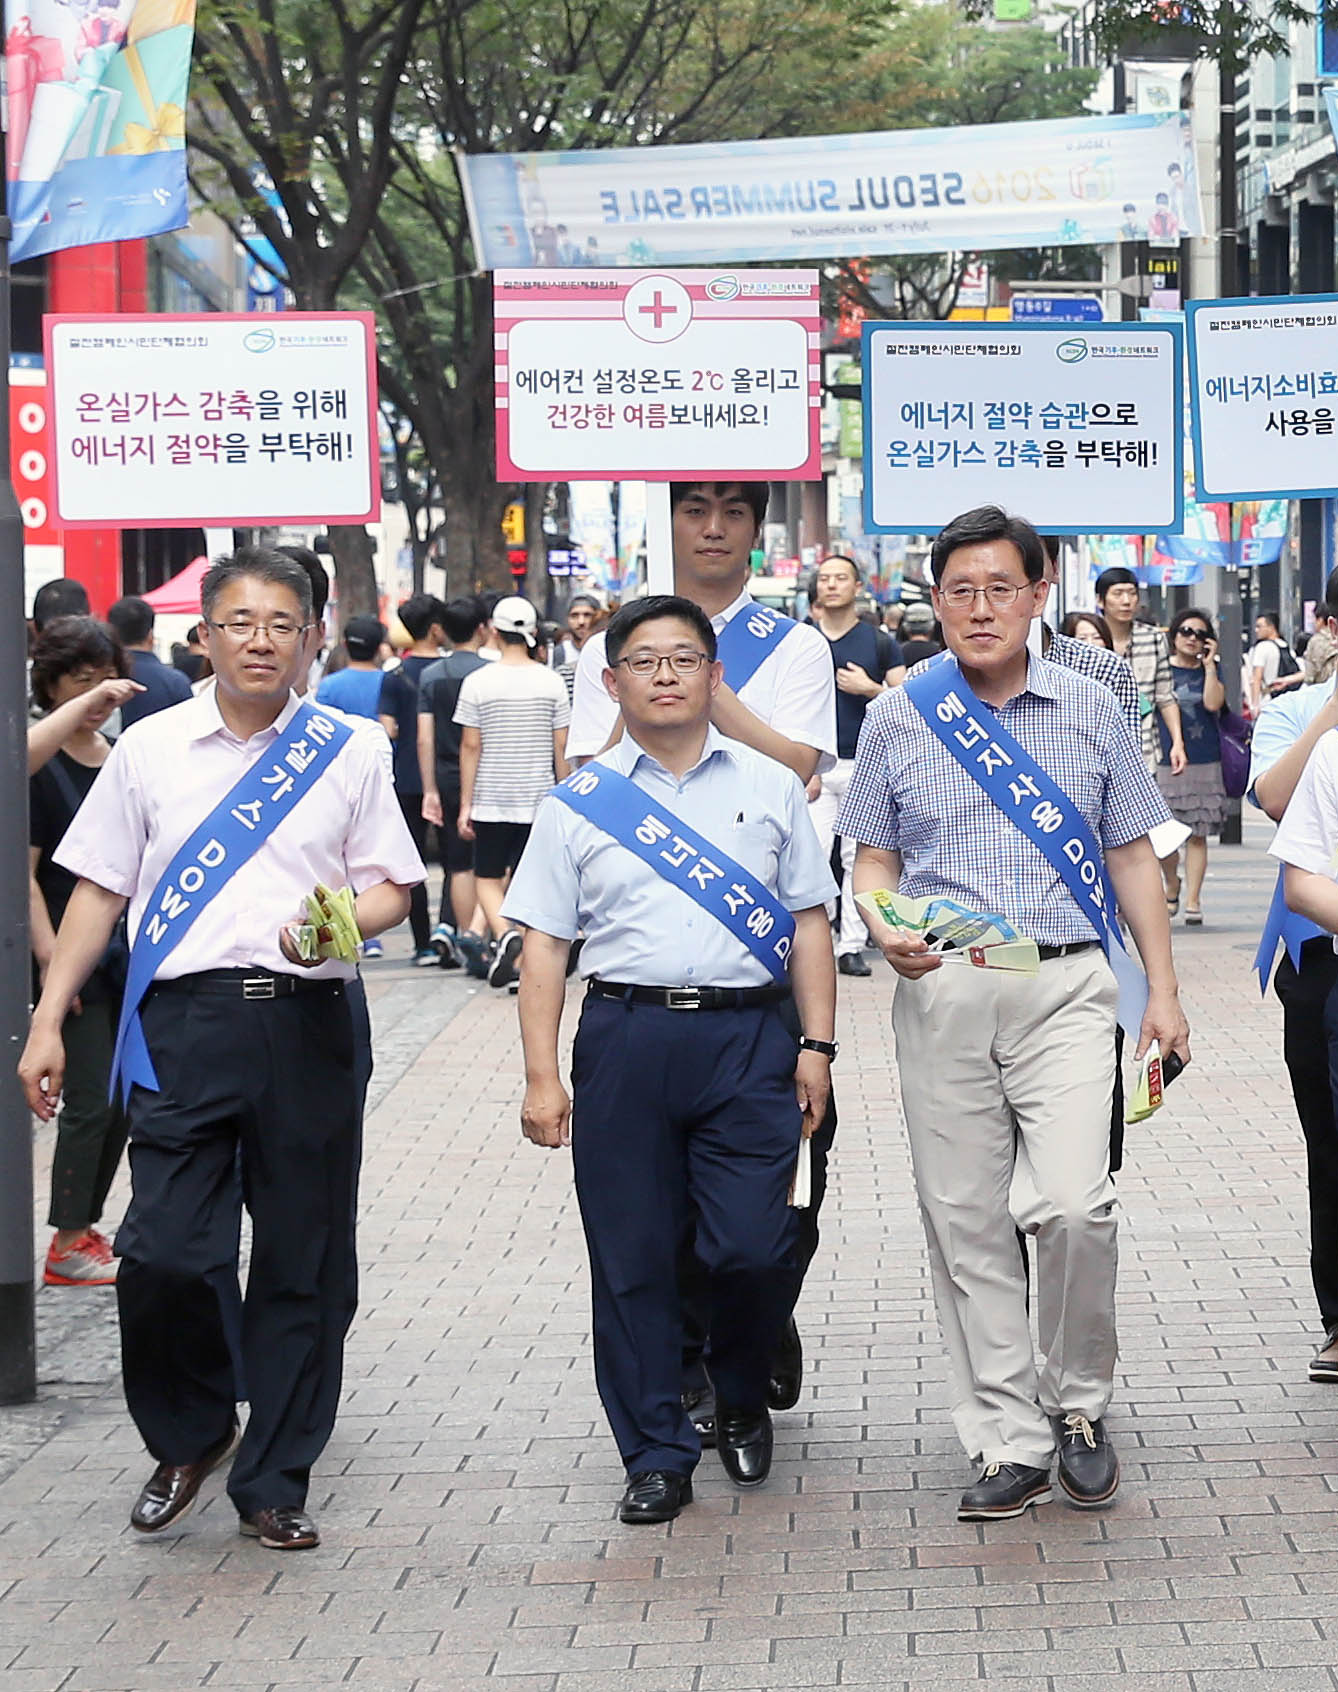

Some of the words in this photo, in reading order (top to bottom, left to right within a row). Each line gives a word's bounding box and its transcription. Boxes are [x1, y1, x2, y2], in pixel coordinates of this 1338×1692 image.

[1209, 315, 1337, 331] 절전캠페인시민단체협의회
[886, 345, 1022, 356] 절전캠페인시민단체협의회
[516, 369, 584, 395] 에어컨
[592, 369, 685, 395] 설정온도
[730, 368, 801, 394] 올리고
[76, 392, 190, 423] 온실가스
[199, 390, 283, 421] 감축을
[292, 389, 348, 420] 위해
[547, 404, 615, 430] 건강한
[900, 401, 973, 430] 에너지
[983, 401, 1033, 430] 절약
[1038, 401, 1138, 429] 습관으로
[1265, 407, 1336, 437] 사용을
[71, 435, 155, 466] 에너지
[166, 433, 250, 465] 절약을
[258, 432, 353, 463] 부탁해!
[886, 440, 987, 468] 온실가스
[994, 440, 1068, 468] 감축을
[1075, 440, 1158, 468] 부탁해!
[231, 713, 337, 831] 온실가스
[935, 691, 1013, 776] 에너지
[1008, 772, 1064, 833] 사용
[145, 838, 227, 945] DOWN
[635, 814, 725, 891] 에너지
[722, 881, 776, 939] 사용
